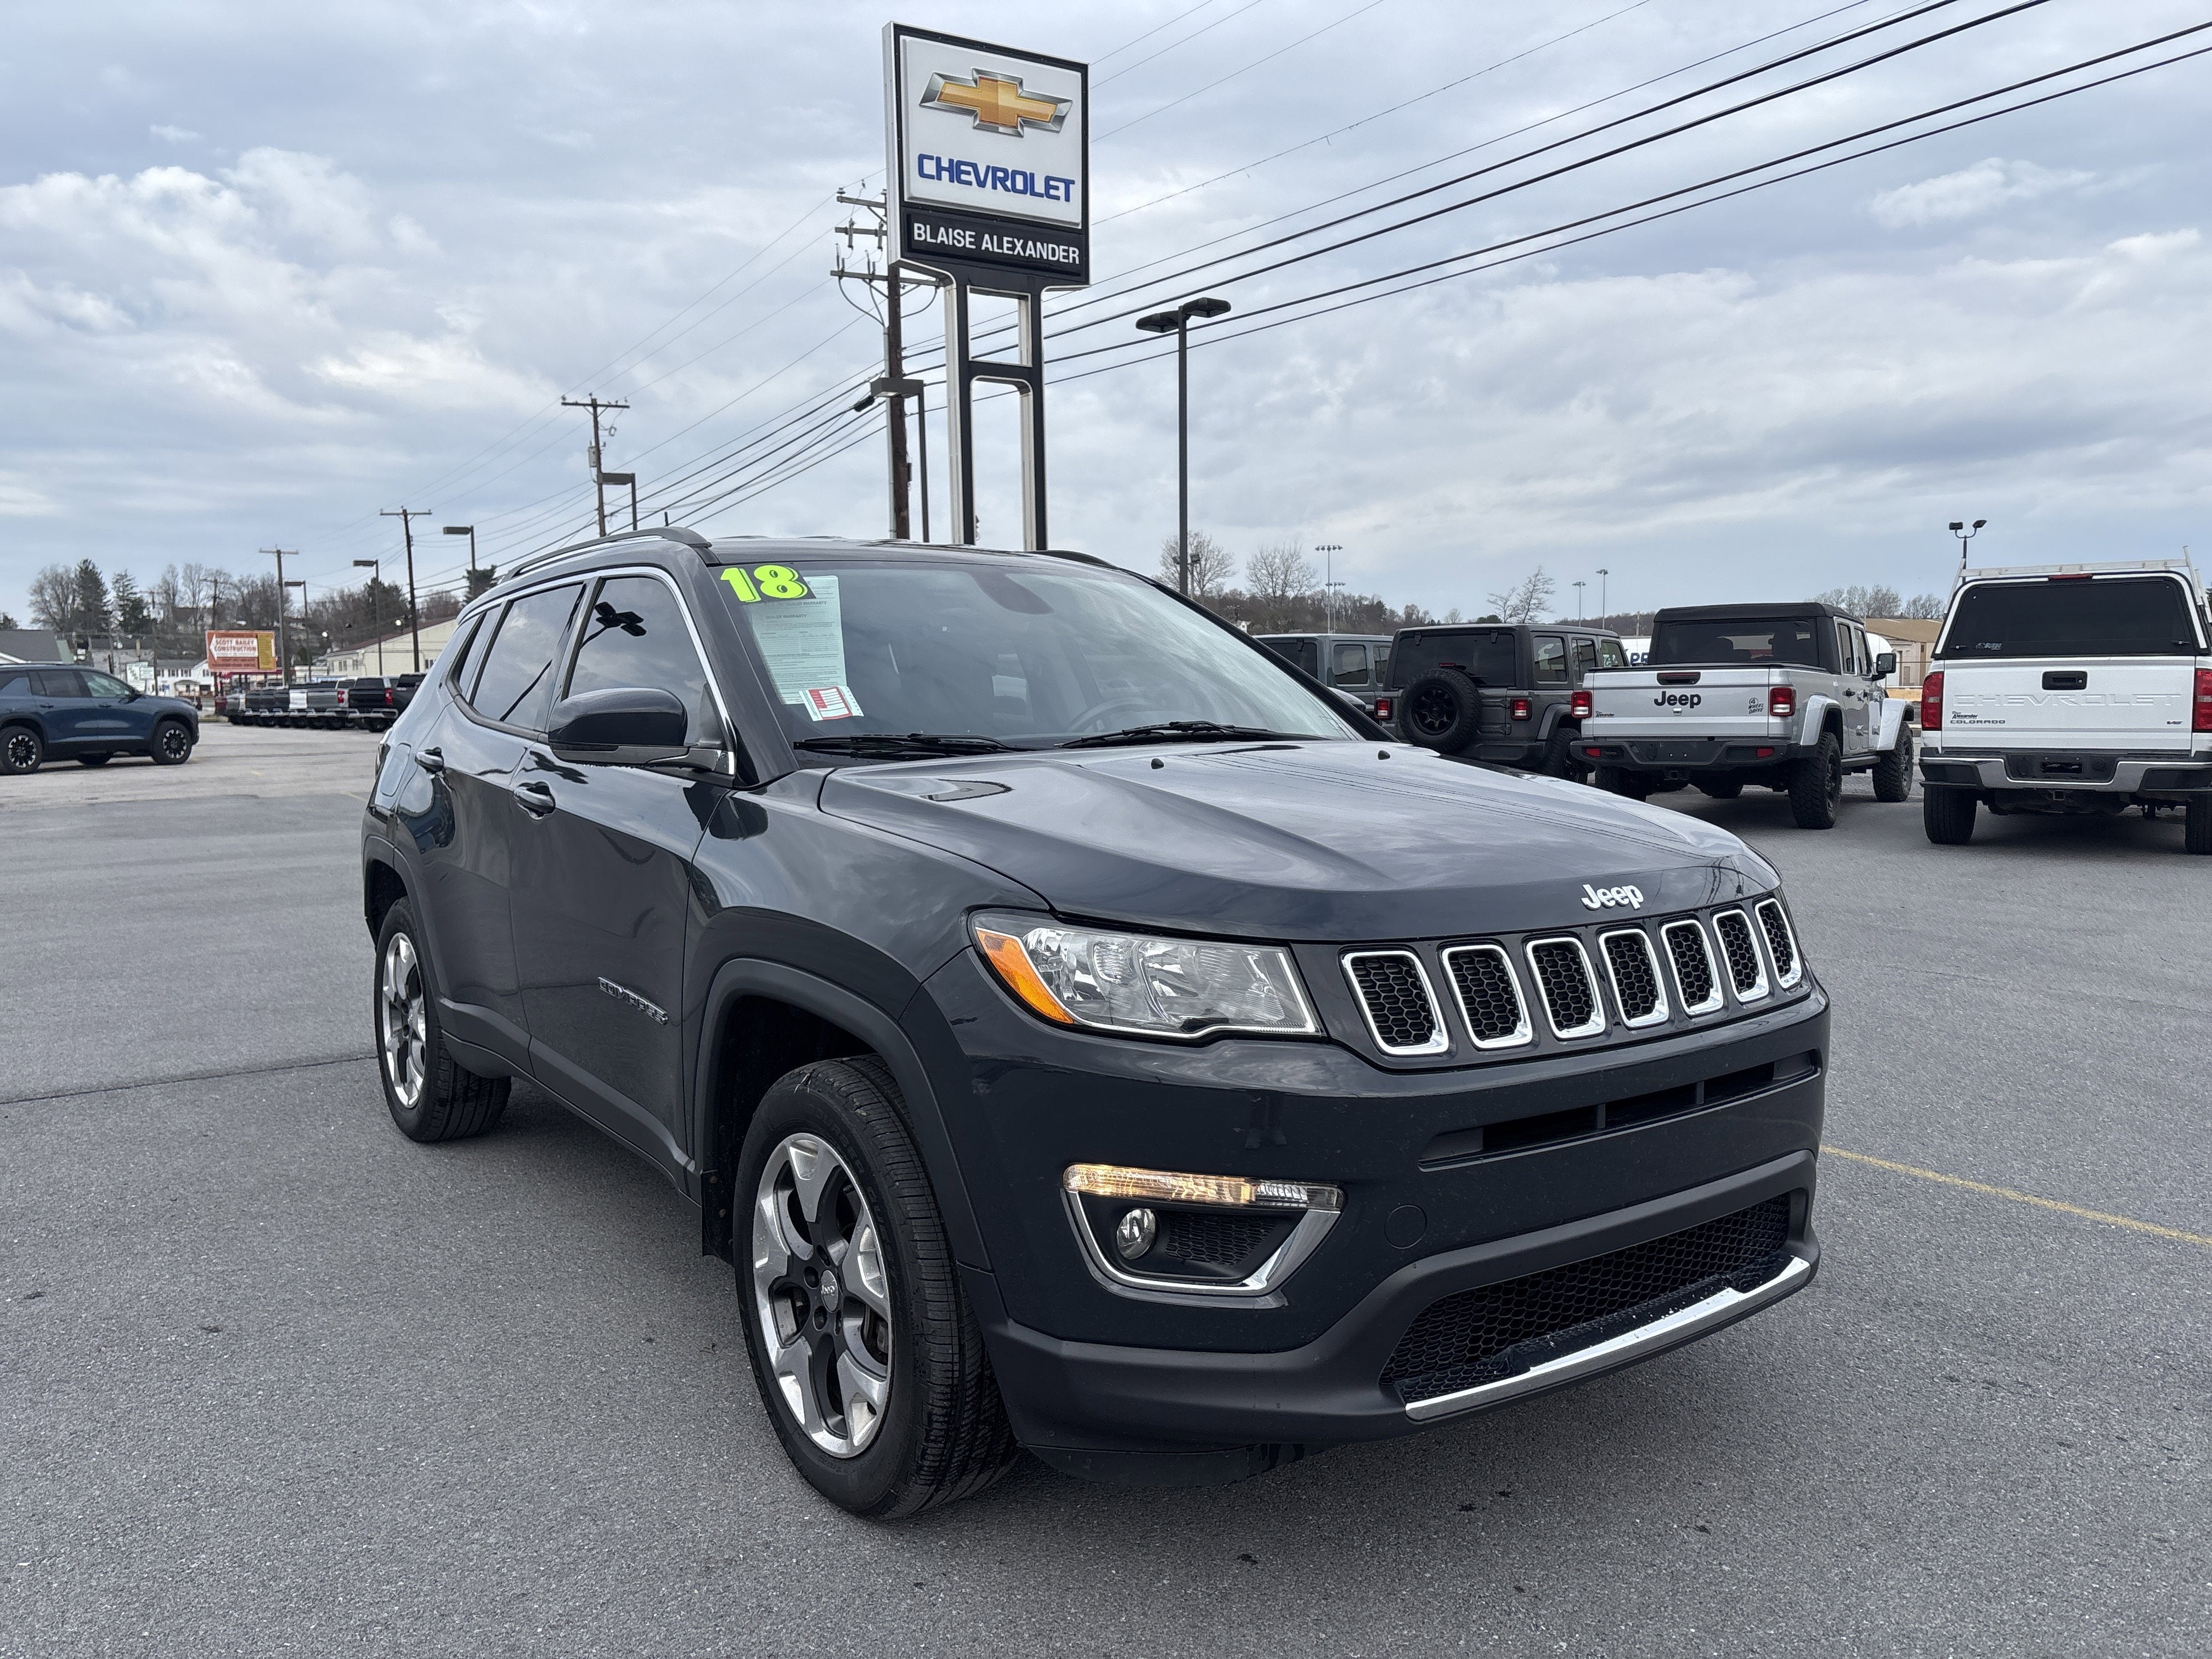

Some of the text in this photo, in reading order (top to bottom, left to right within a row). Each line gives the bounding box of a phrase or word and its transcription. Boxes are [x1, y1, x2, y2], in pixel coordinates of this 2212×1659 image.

[918, 154, 1075, 202] CHEVROLET
[913, 223, 1080, 264] BLAISE ALEXANDER
[720, 565, 808, 602] 18
[1654, 691, 1701, 708] Jeep
[1953, 695, 2182, 706] CHEVROLET
[1580, 883, 1644, 911] Jeep
[597, 977, 669, 1025] COMPASS
